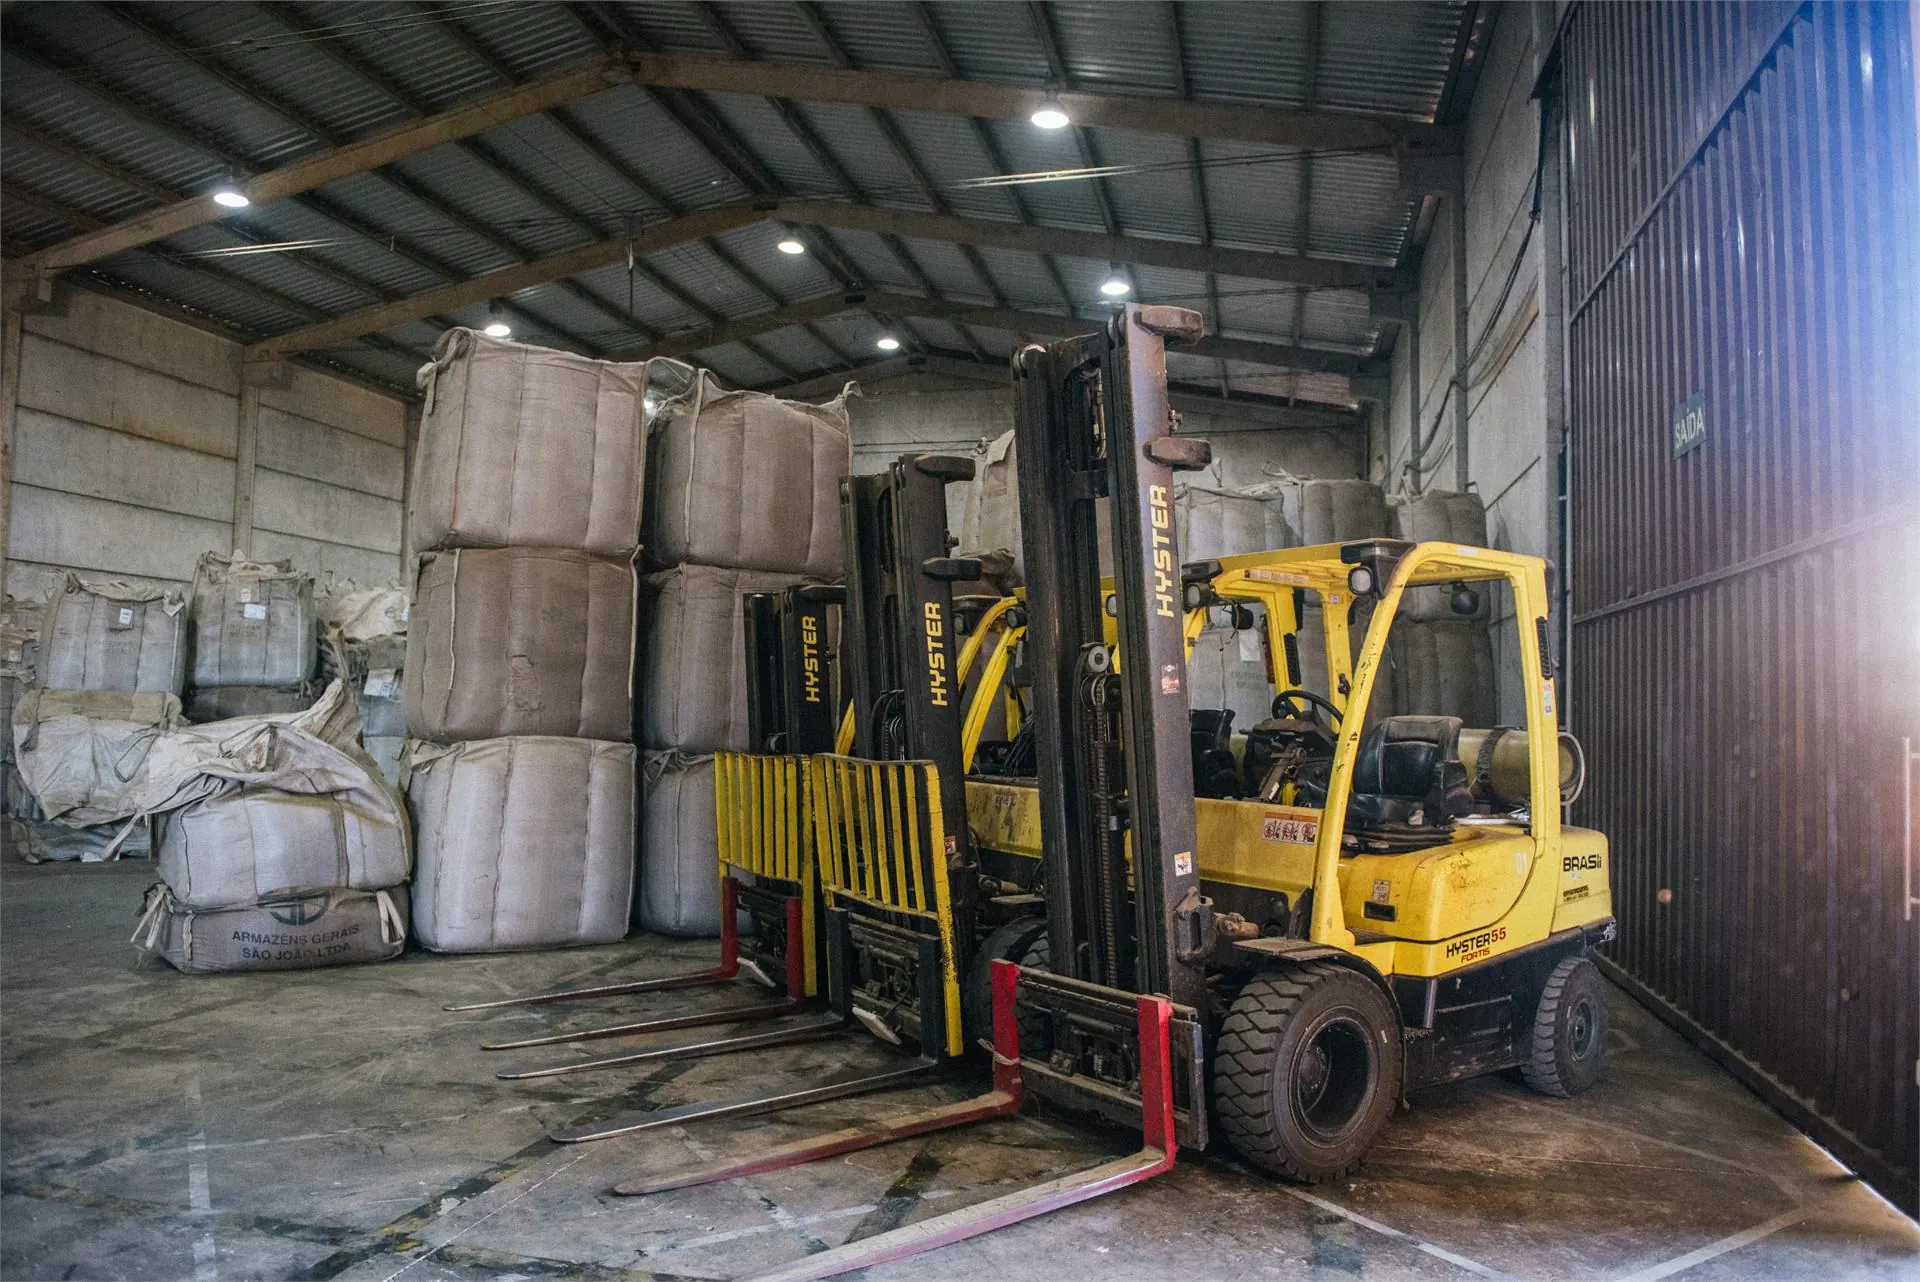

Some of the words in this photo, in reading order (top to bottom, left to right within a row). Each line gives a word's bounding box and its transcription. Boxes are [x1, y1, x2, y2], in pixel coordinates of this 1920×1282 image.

[1675, 406, 1705, 449] SAÍDA
[1150, 484, 1174, 618] HYSTER
[802, 615, 820, 702] HYSTER
[925, 602, 948, 706] HYSTER
[311, 924, 360, 944] GERAIS
[317, 942, 351, 958] LTDA
[1446, 932, 1490, 958] HYSTER
[1491, 926, 1506, 943] 55
[1461, 947, 1490, 963] FORTIS
